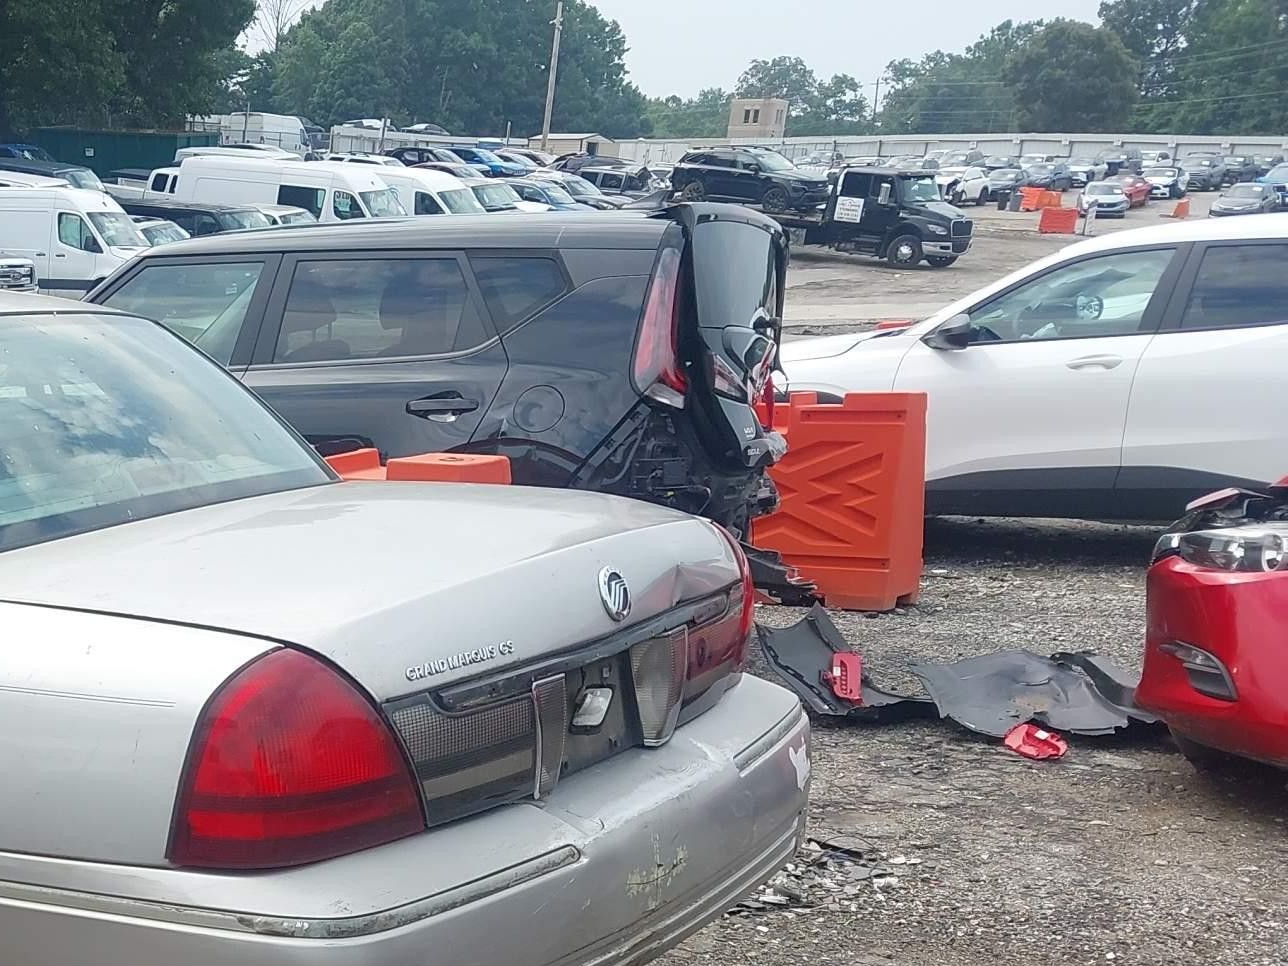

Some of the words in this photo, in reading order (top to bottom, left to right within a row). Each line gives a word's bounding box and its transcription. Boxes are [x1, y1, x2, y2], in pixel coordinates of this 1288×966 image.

[406, 659, 447, 681] GRAND
[448, 646, 496, 670] MARQUIS
[499, 640, 515, 656] GS
